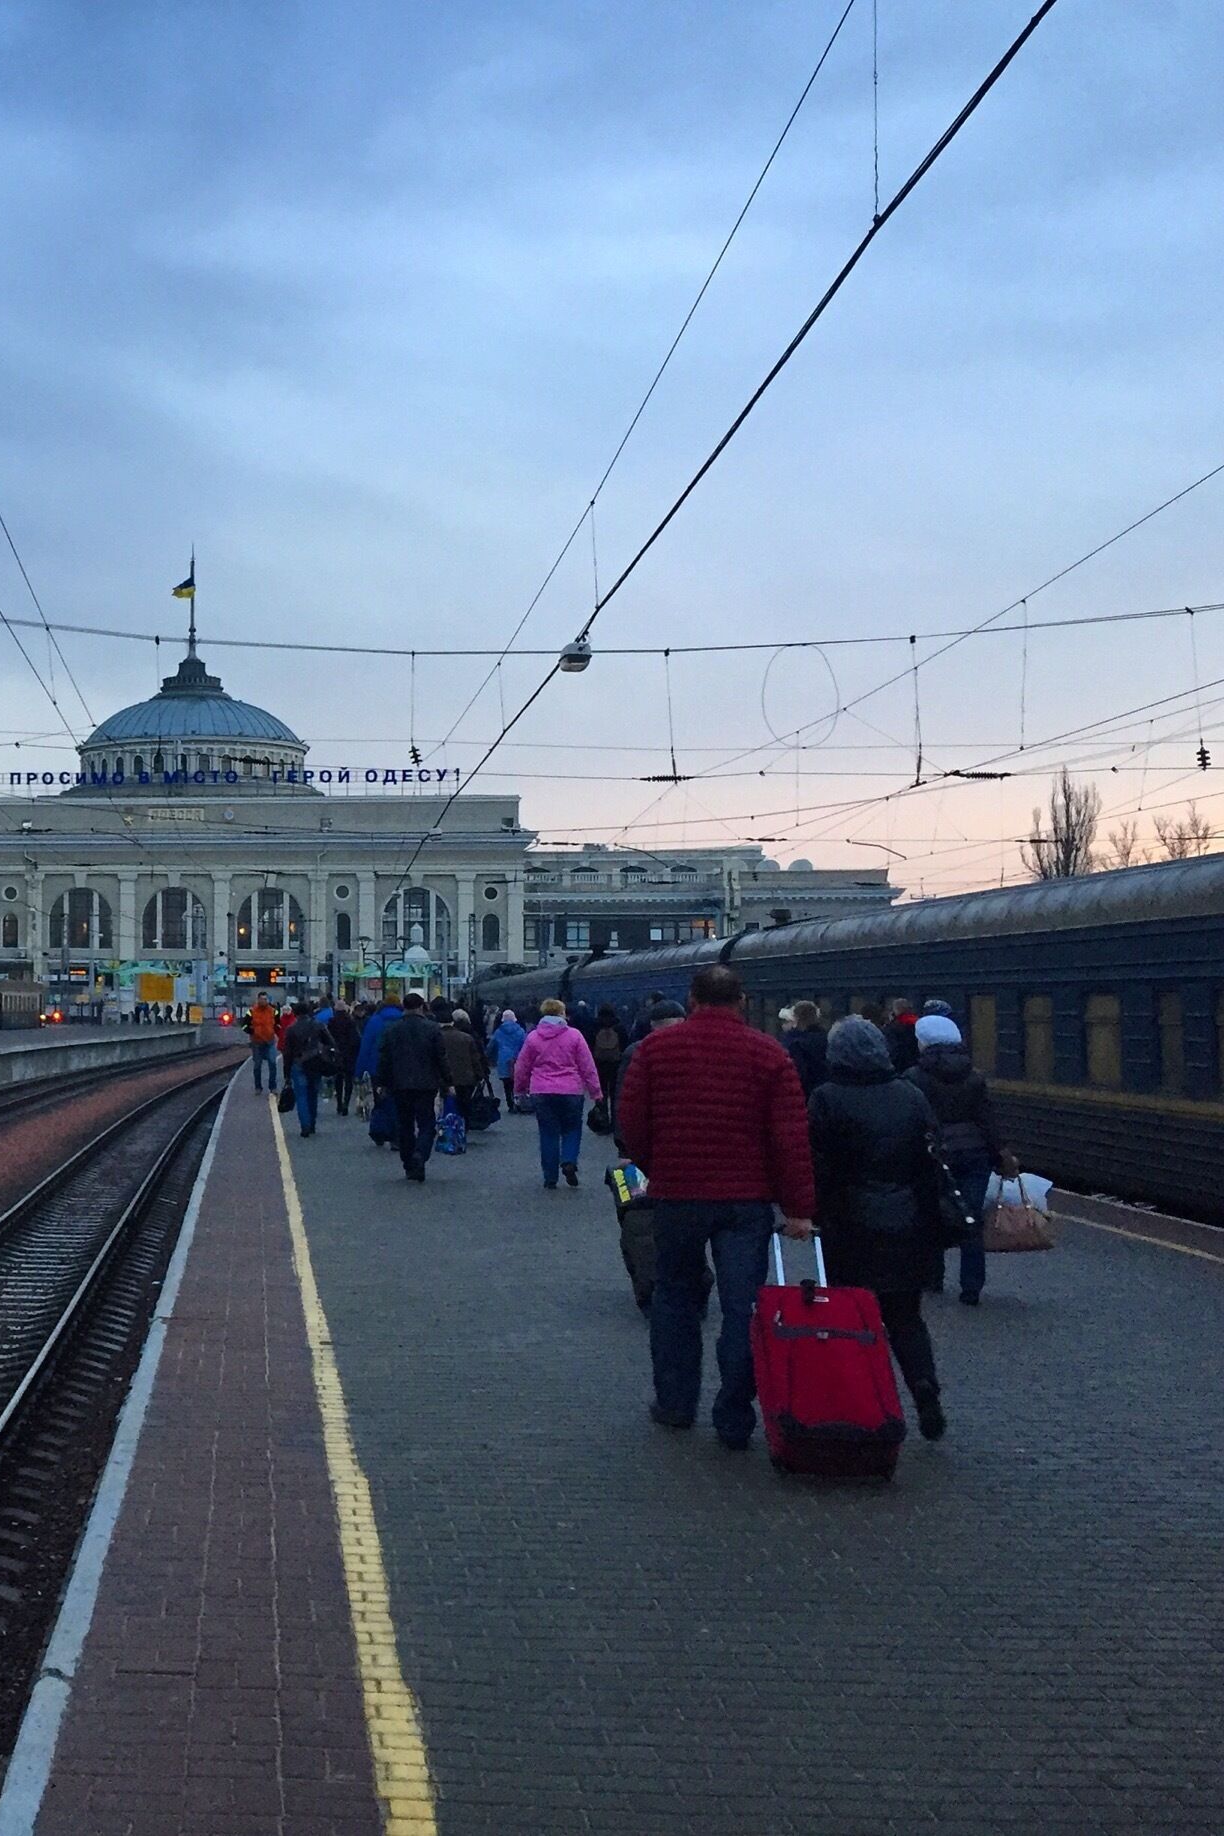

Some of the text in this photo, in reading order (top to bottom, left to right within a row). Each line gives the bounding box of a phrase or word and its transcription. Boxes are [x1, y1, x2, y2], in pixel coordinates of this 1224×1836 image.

[10, 771, 125, 785] ПРОСИМО
[138, 771, 151, 785] В
[163, 770, 239, 784] МІСТО
[272, 767, 350, 784] ГЕРОЙ
[365, 768, 460, 785] ОДЕСУ!
